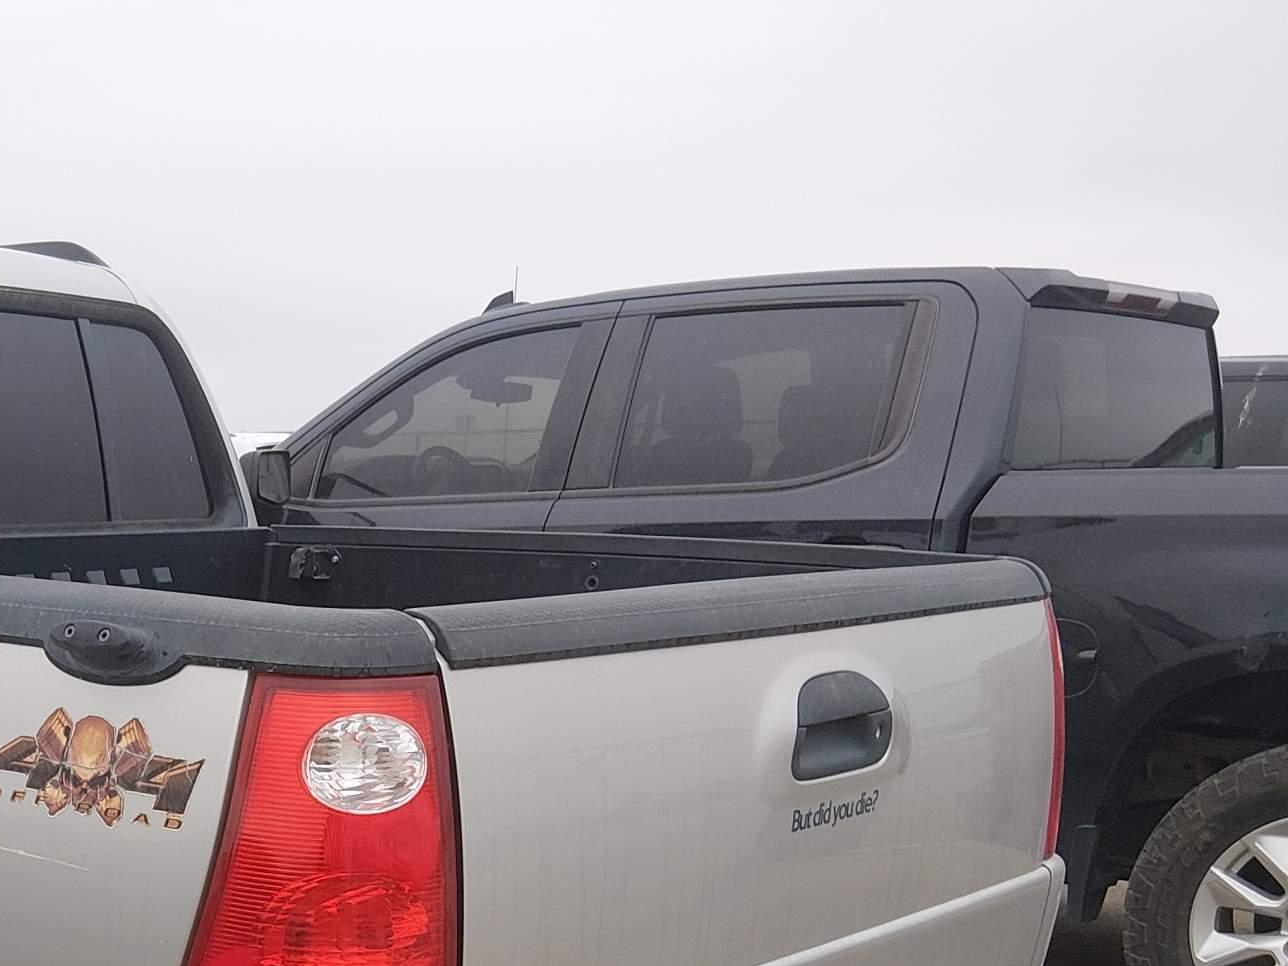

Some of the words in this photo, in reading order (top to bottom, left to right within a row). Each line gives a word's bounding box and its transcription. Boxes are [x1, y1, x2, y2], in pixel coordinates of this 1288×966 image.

[791, 809, 812, 832] But
[813, 800, 832, 827] did
[831, 801, 854, 828] you
[855, 789, 880, 816] die?
